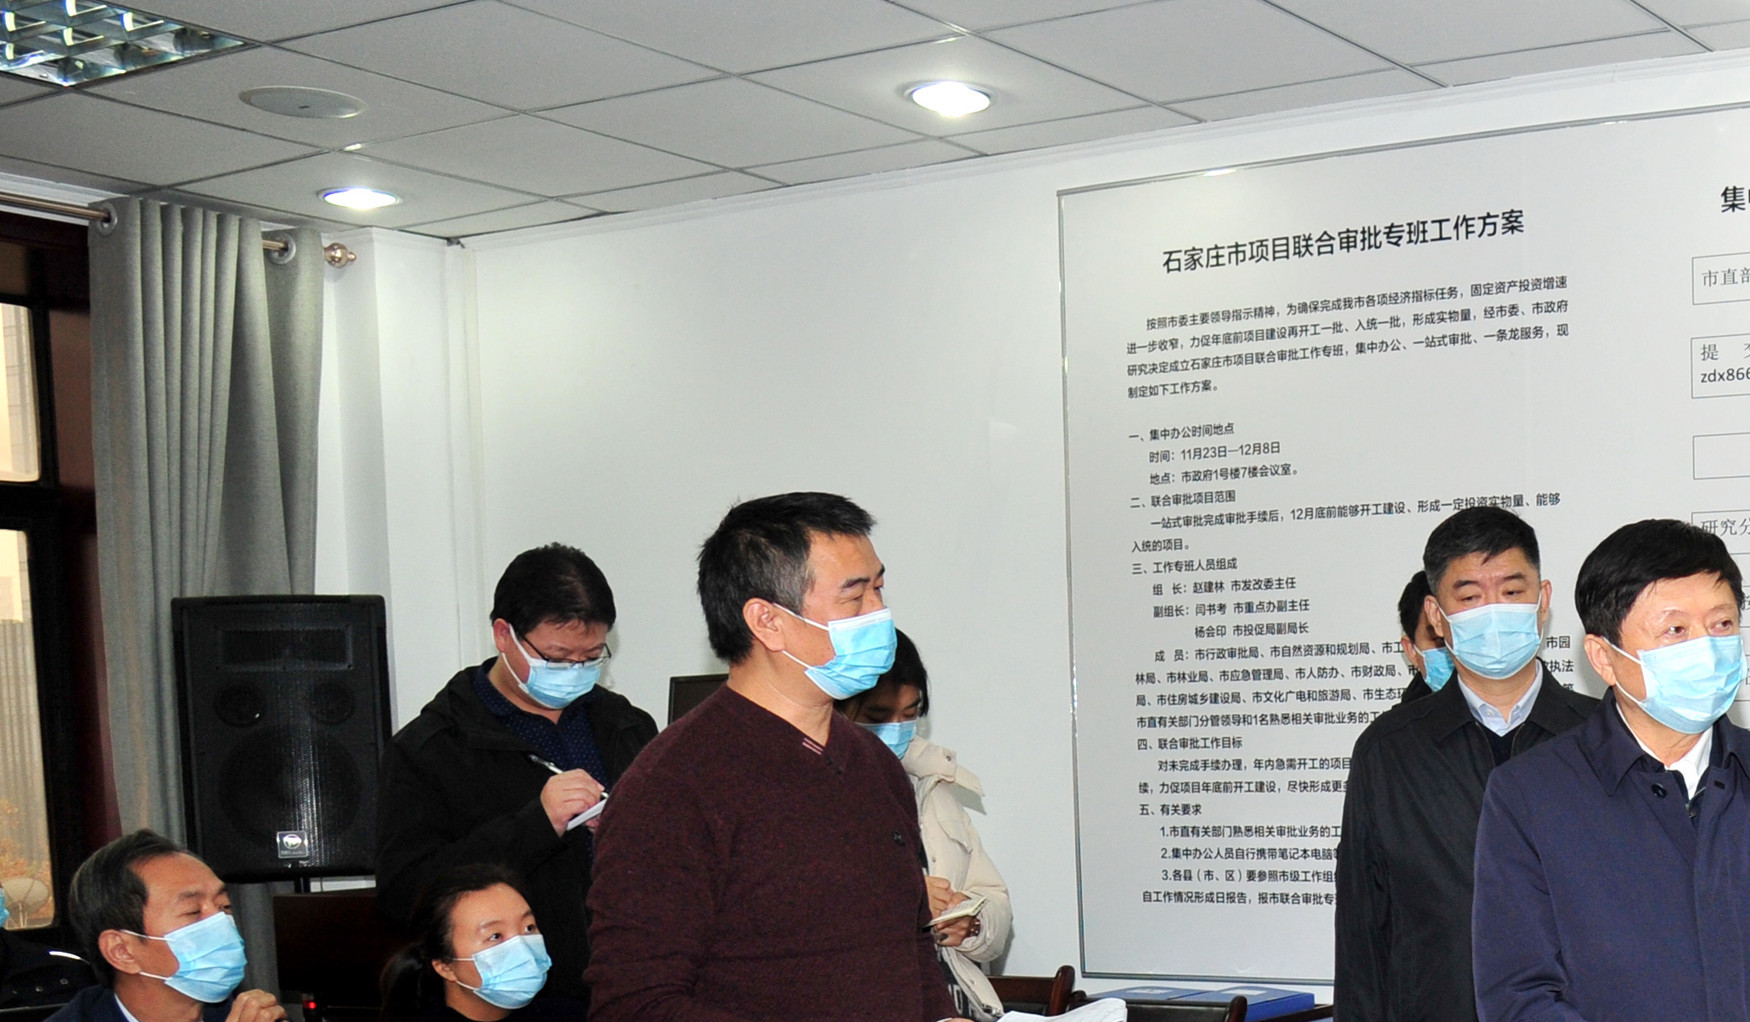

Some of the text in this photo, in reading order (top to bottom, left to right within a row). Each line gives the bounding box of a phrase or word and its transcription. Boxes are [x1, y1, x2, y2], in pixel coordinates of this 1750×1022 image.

[1162, 209, 1525, 274] 石家庄市项目联合审批专班工作方案
[1128, 380, 1218, 399] 制定如下工作方案。
[1129, 423, 1235, 442] 一、集中办公时间地点
[1149, 463, 1298, 485] 地点：市政府1号楼7楼会议室。
[1130, 490, 1236, 509] 二、联合审批项目范围
[1131, 538, 1190, 553] 入统的项目。
[1132, 558, 1238, 575] 三、工作专班人员组成
[1231, 577, 1297, 591] 市发改委主任
[1233, 599, 1310, 614] 市重点办副主任
[1546, 635, 1571, 649] 市园
[1544, 659, 1574, 673] 执法
[1136, 711, 1386, 729] 市直有关部门分管领导和1名熟悉相关审批业务的工
[1137, 737, 1243, 751] 四、联合审批工作目标
[1139, 804, 1202, 816] 五、有关要求
[1162, 869, 1337, 883] 3.各县（市、区）要参照市级工作组
[1143, 891, 1337, 905] 自工作情况形成日报告，报市联合审批专
